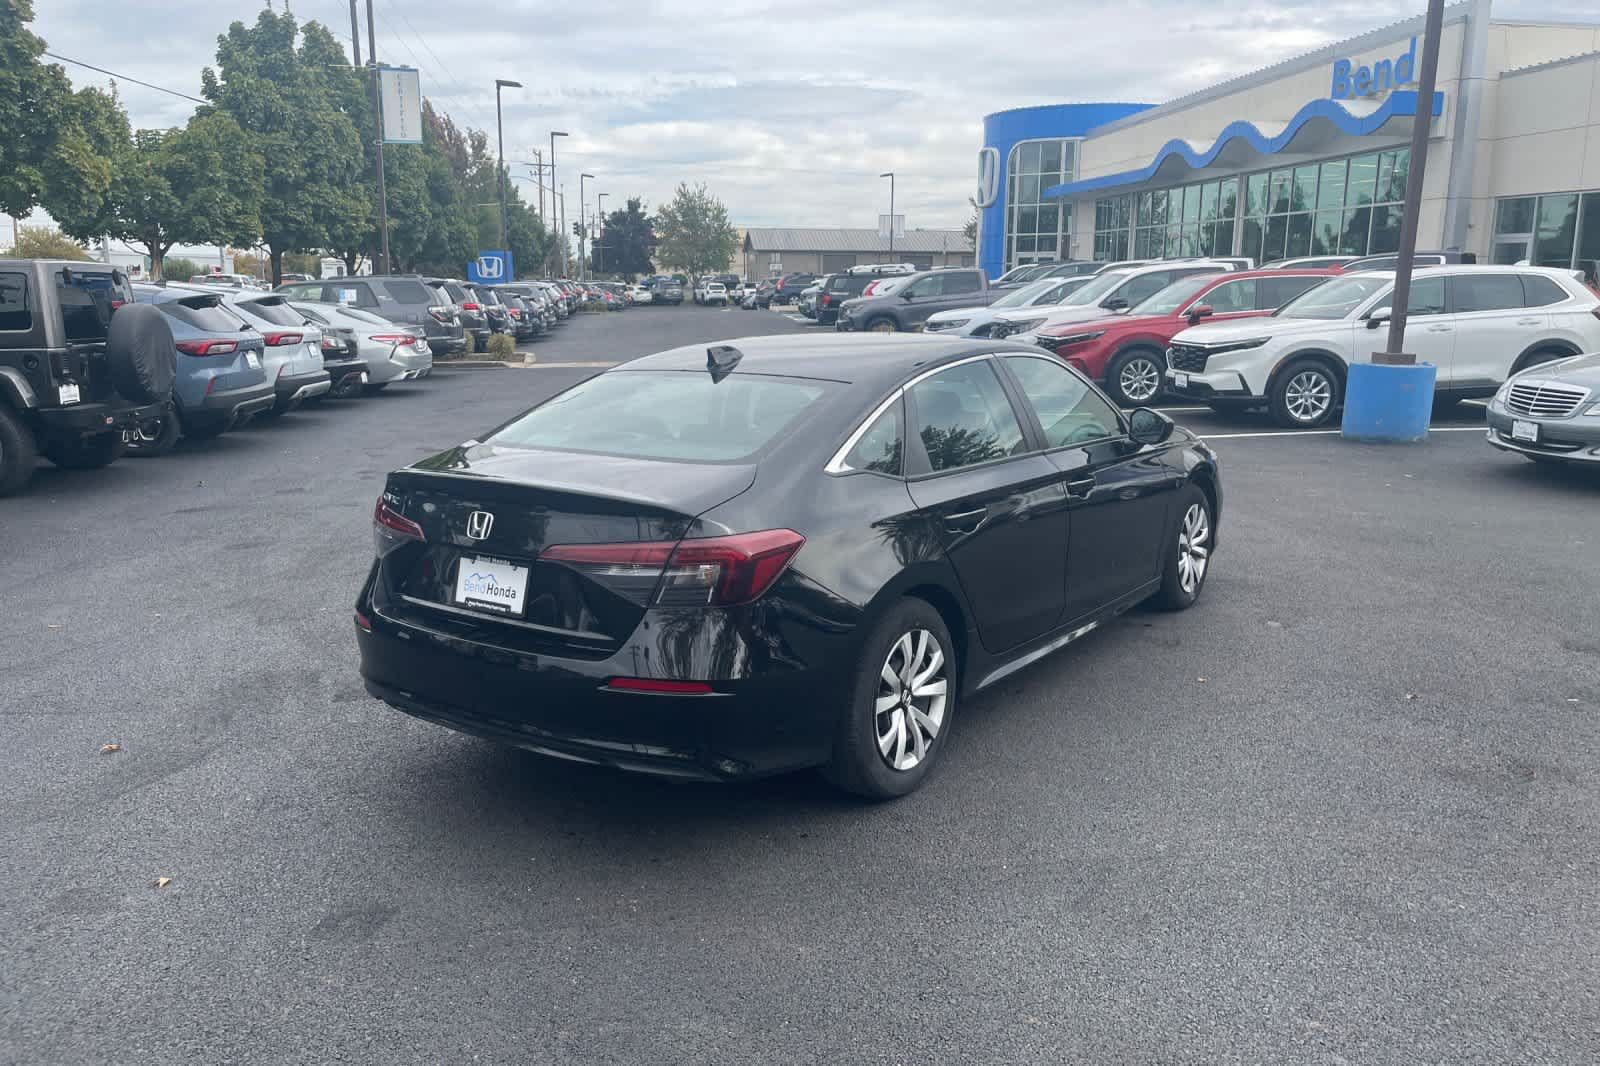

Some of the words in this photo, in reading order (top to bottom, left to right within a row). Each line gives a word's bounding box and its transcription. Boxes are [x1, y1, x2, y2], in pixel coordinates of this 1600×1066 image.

[1331, 37, 1417, 99] Bend
[464, 579, 486, 593] Bend
[486, 582, 517, 599] Honda
